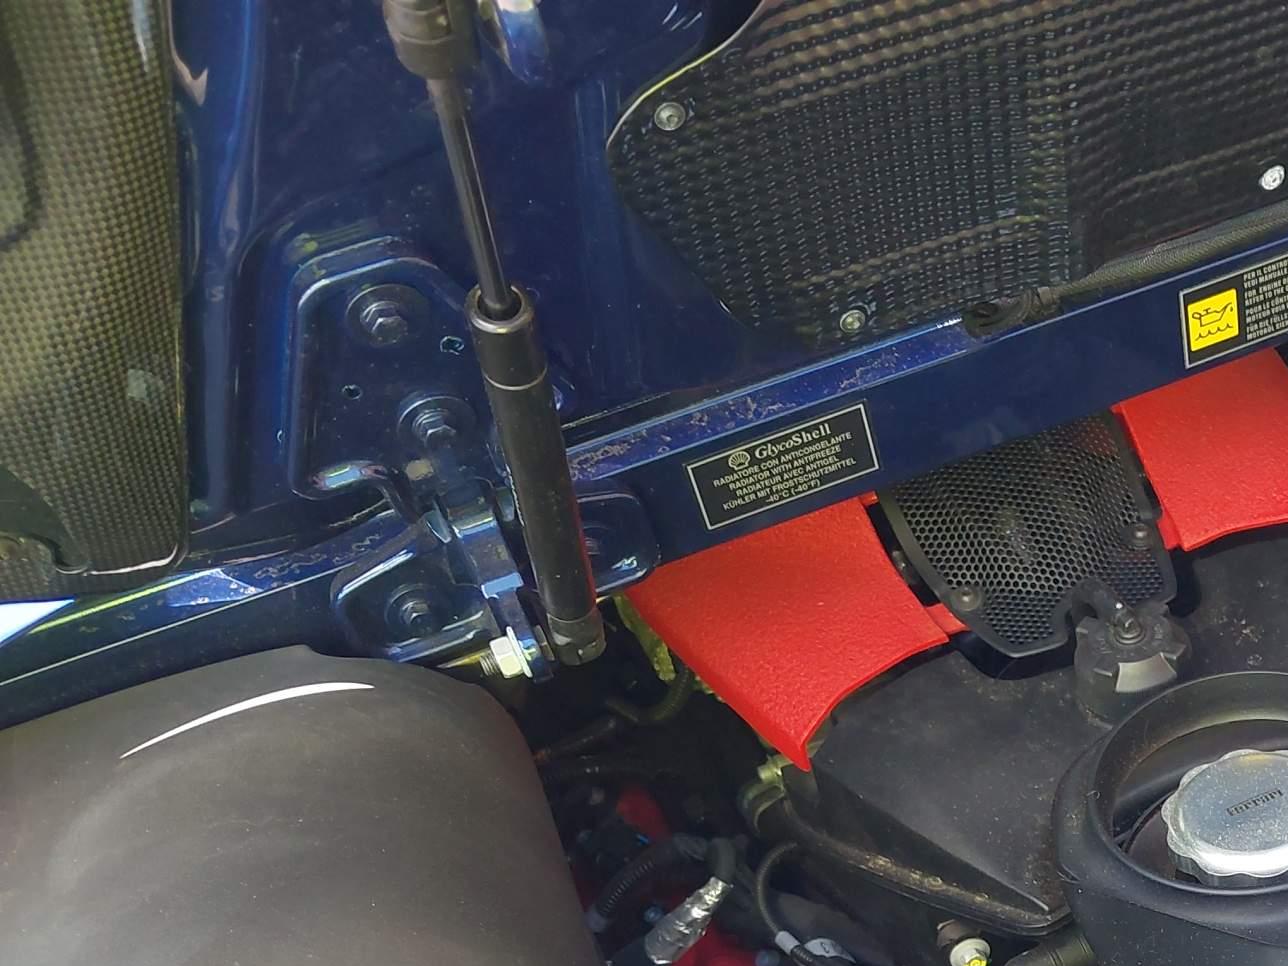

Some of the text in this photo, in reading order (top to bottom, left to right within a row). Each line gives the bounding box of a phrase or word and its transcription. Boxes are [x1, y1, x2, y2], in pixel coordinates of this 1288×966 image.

[1243, 270, 1255, 281] PER
[1256, 267, 1262, 276] IL
[1243, 277, 1257, 288] VEDI
[1258, 267, 1287, 283] MANUALE
[1244, 288, 1256, 298] FOR
[1258, 279, 1281, 293] ENGINE
[1244, 293, 1263, 306] REFER
[1264, 290, 1272, 299] TO
[1273, 286, 1284, 296] THE
[1245, 303, 1261, 316] POUR
[1262, 301, 1269, 309] LE
[1245, 308, 1270, 323] MOTEUR
[754, 423, 831, 459] GlycoShell
[712, 431, 851, 487] RADIATORE CON ANTICONGELANTE
[728, 444, 841, 490] RADIATOR WITH ANTIFREEZE
[735, 454, 839, 497] RADIATEUR AVEC ANTIGEL
[756, 487, 772, 498] MIT
[771, 456, 856, 492] FROSTSCHUTZMITTEL
